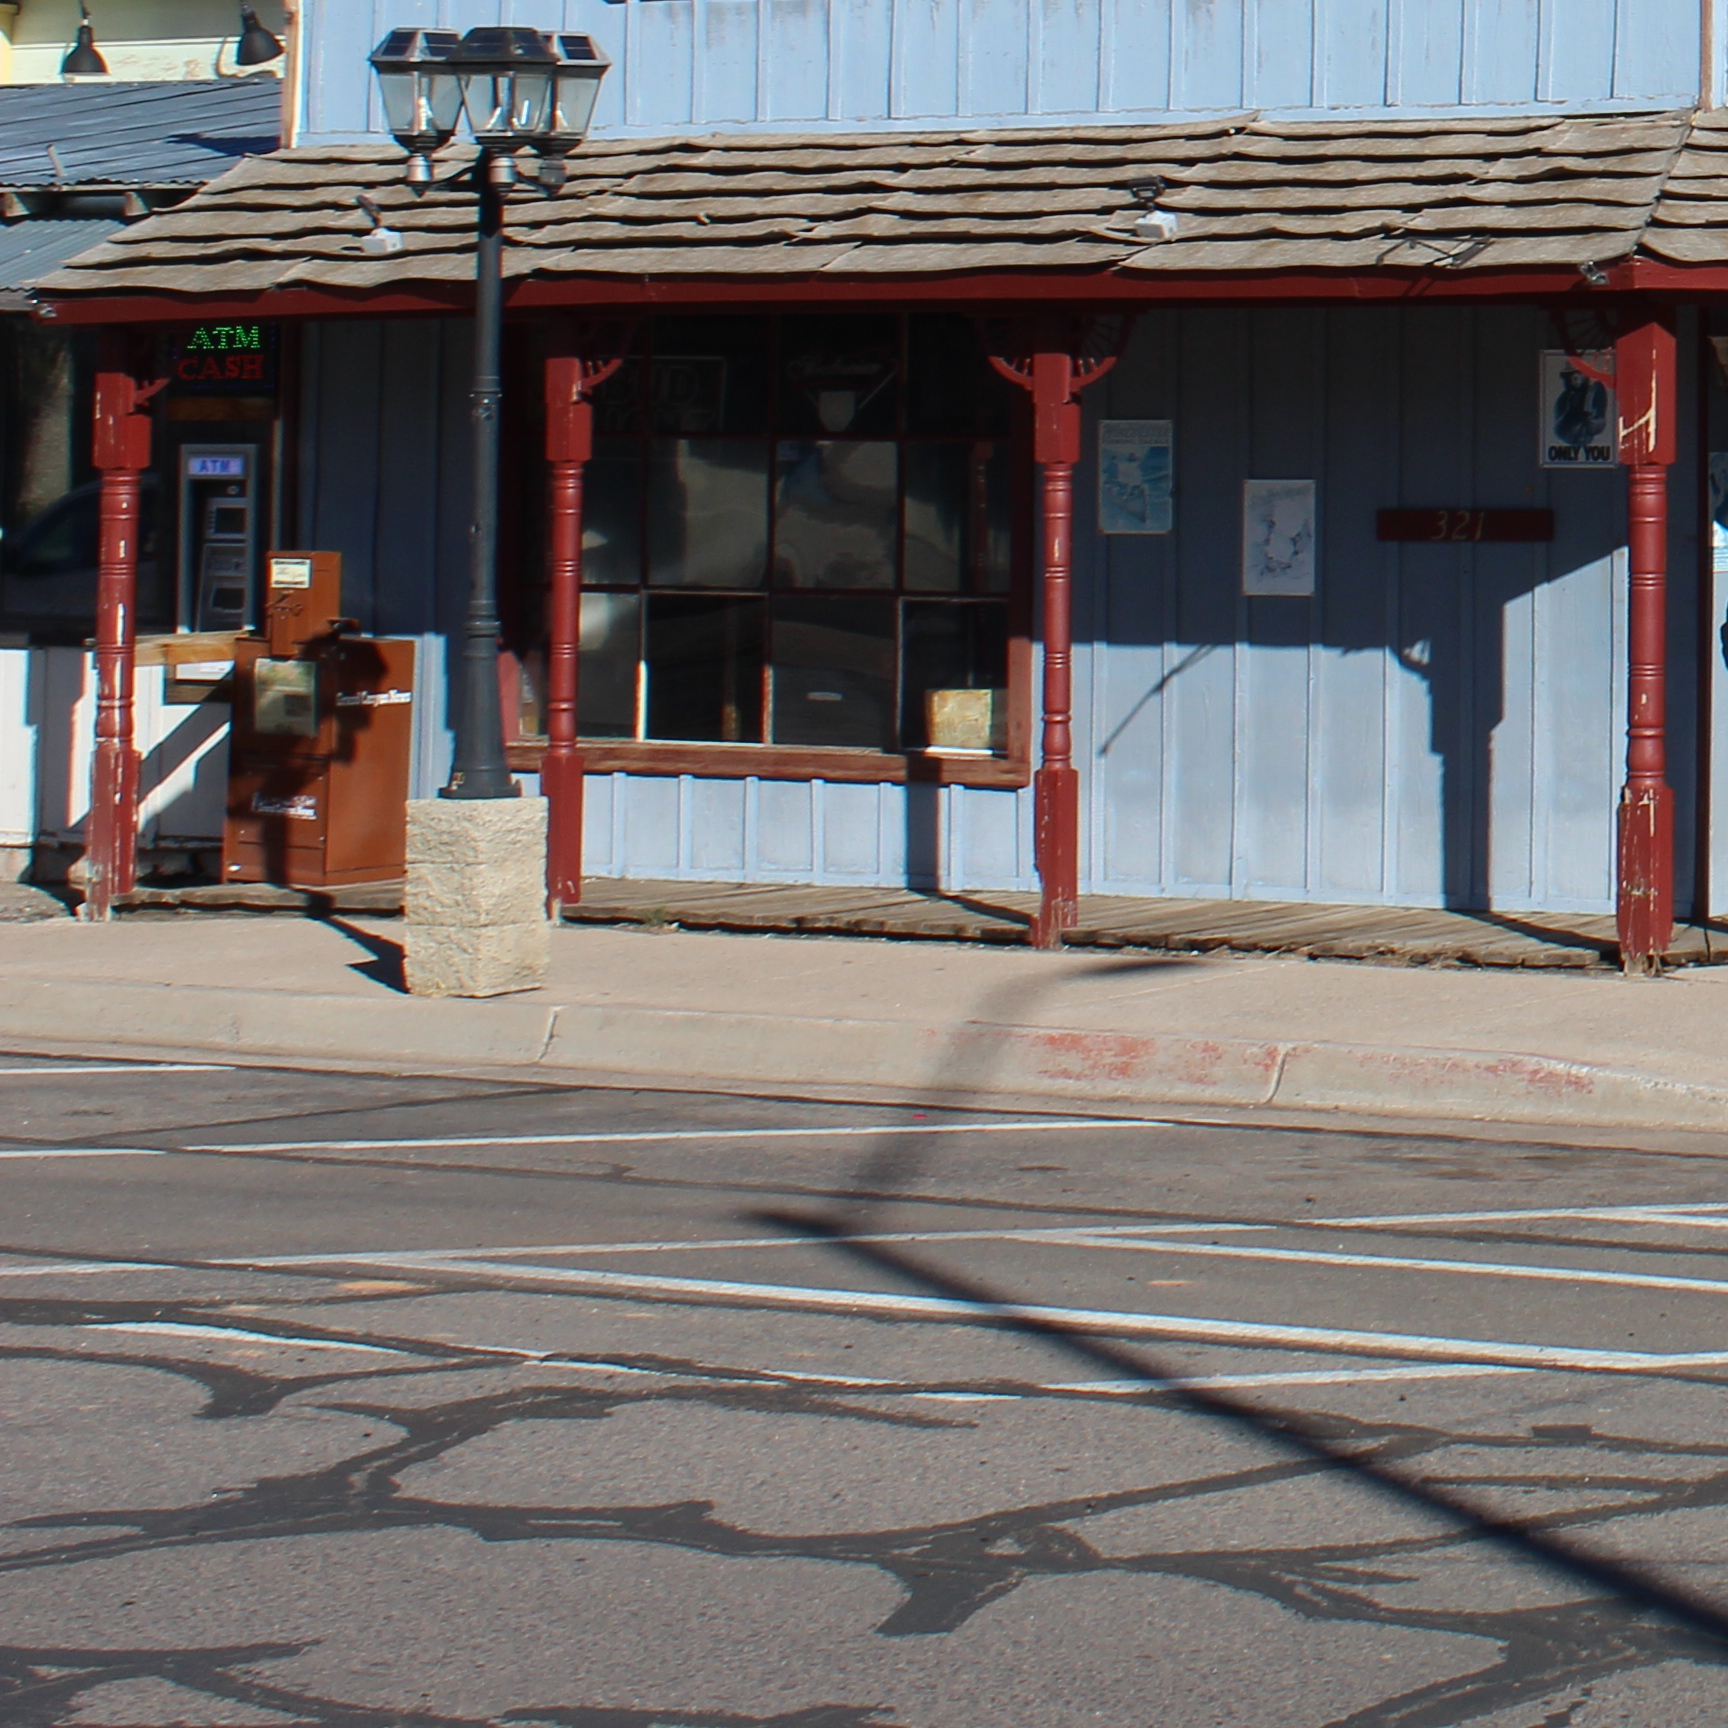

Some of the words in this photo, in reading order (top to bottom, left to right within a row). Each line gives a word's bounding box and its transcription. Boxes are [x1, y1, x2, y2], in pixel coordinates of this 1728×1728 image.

[186, 325, 261, 350] ATM
[176, 354, 266, 381] CASH
[1548, 445, 1581, 461] ONLY
[1584, 445, 1611, 461] YOU
[198, 459, 232, 473] ATM
[1430, 510, 1486, 541] 321
